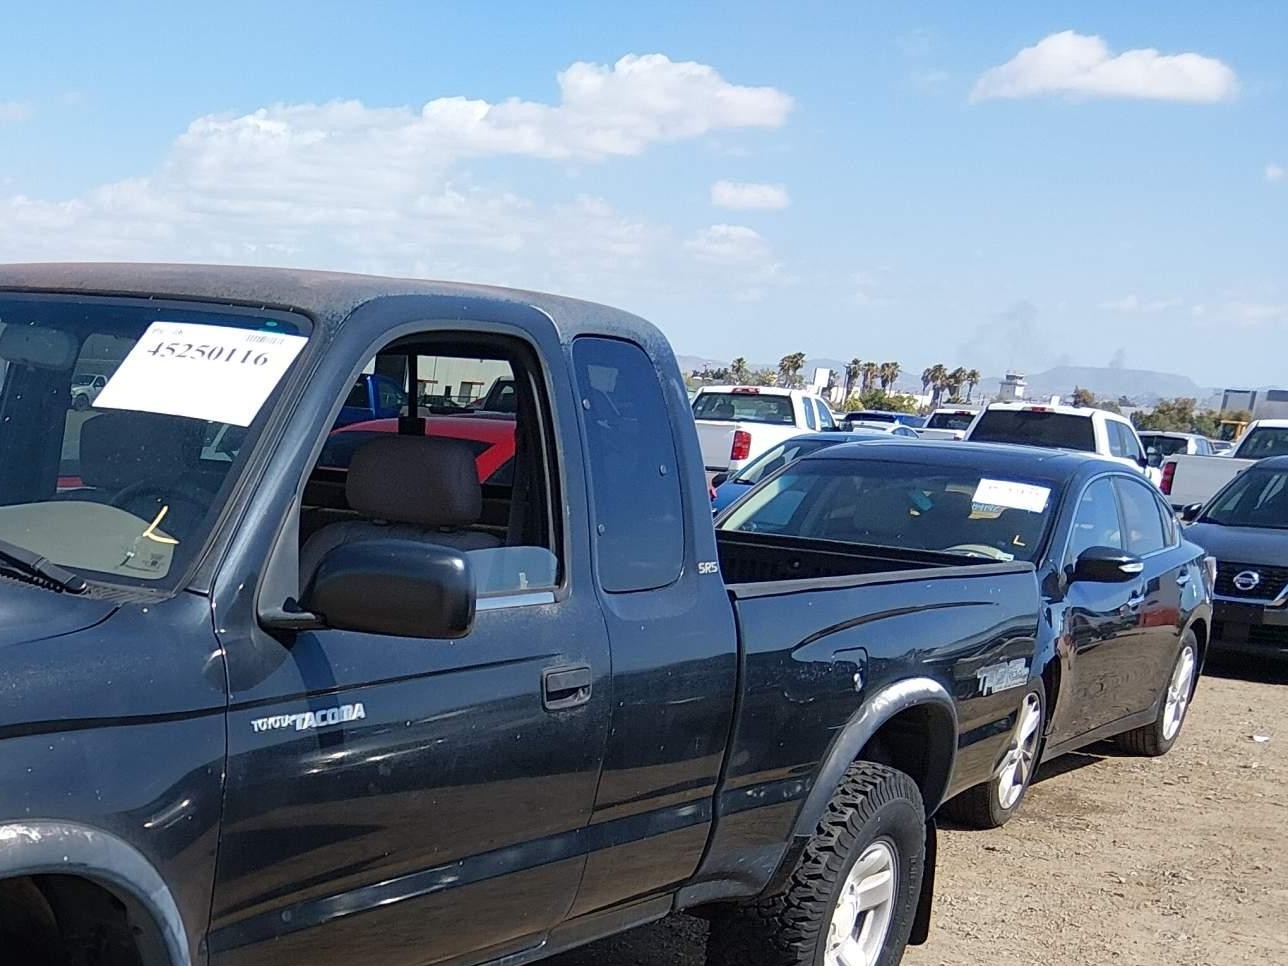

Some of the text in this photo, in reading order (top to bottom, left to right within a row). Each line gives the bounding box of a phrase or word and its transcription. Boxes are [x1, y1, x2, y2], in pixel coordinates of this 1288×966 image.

[146, 341, 269, 366] 45250116
[698, 561, 718, 574] SR5
[294, 703, 365, 731] TACOMA
